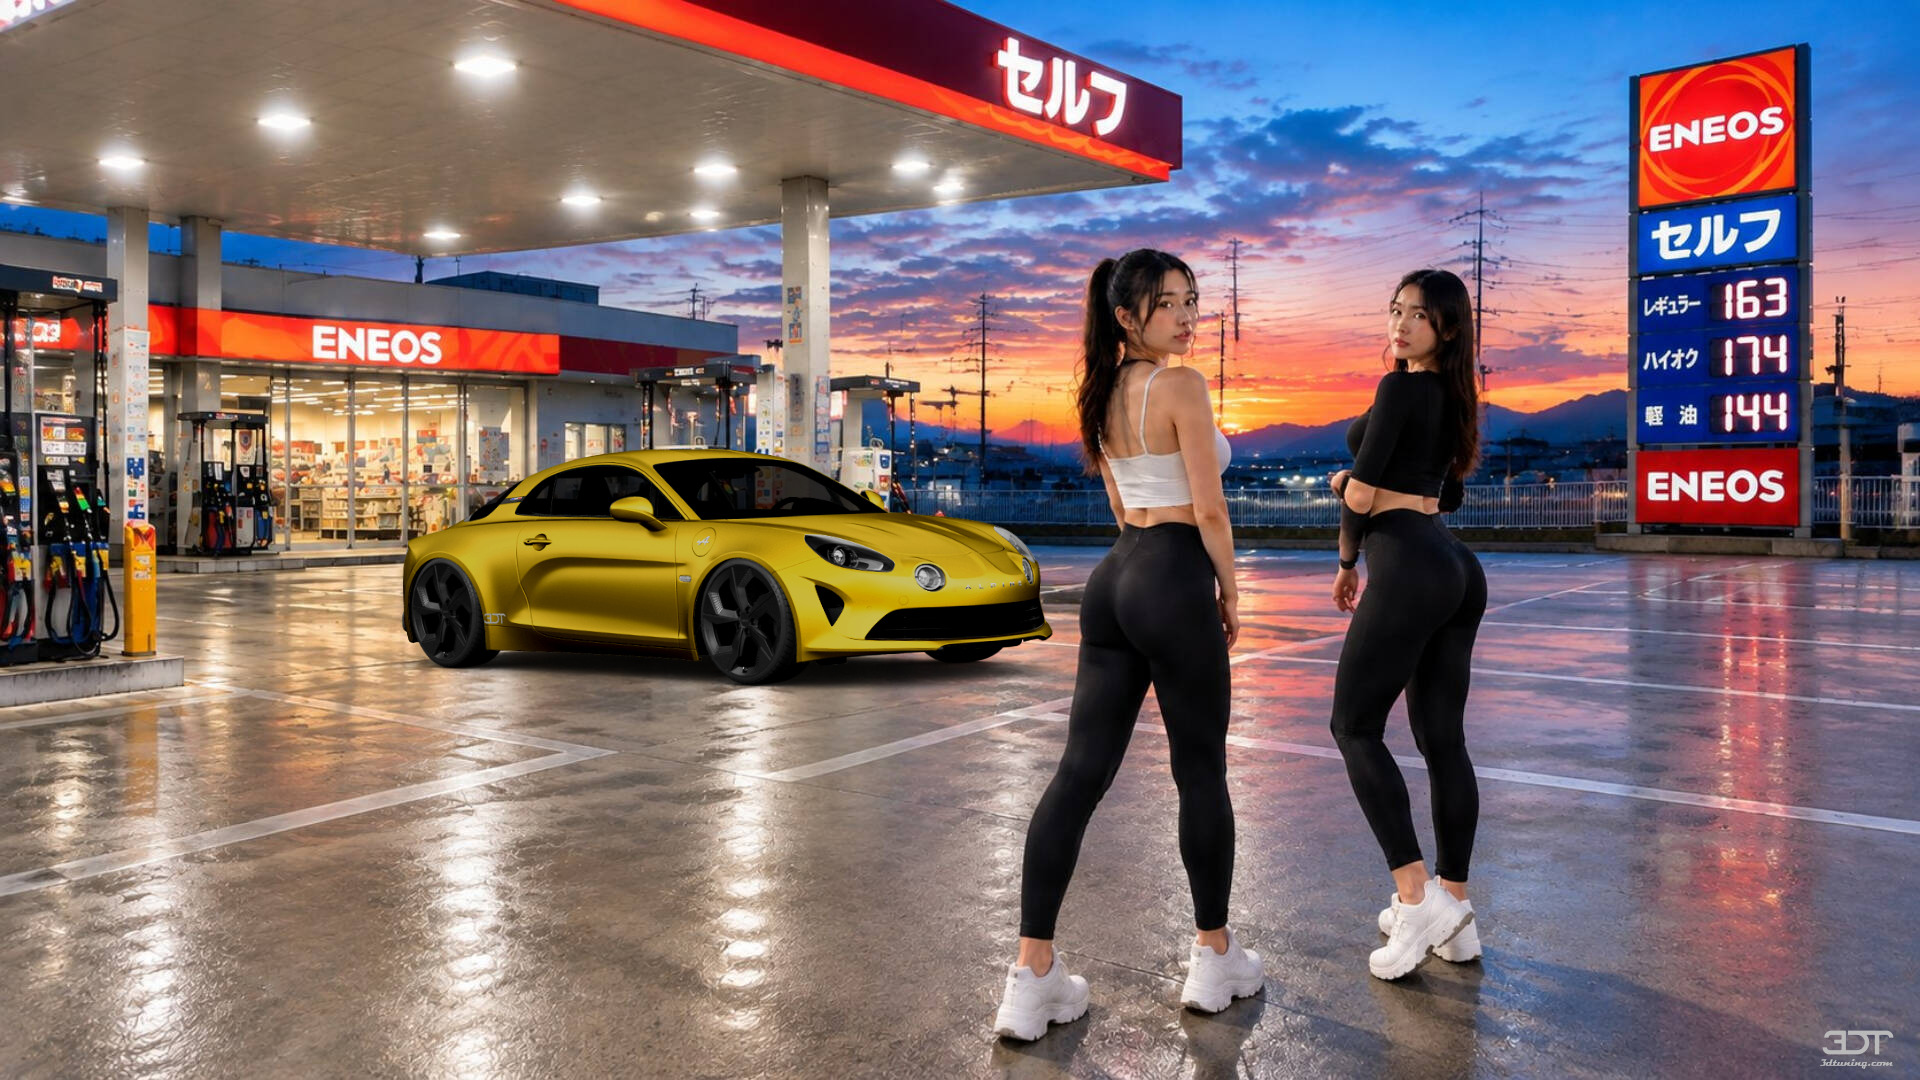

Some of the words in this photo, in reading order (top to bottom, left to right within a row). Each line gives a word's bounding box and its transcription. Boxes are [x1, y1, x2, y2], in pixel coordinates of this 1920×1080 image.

[998, 38, 1126, 135] セルフ
[1650, 107, 1783, 151] ENEOS
[1651, 209, 1780, 259] セルフ
[1644, 295, 1701, 316] レギュラー
[1723, 278, 1787, 320] 163
[312, 326, 441, 365] ENEOS
[1643, 348, 1697, 370] ハイオク
[1723, 335, 1787, 376] 174
[1723, 392, 1787, 432] 144
[1647, 470, 1785, 503] ENEOS
[484, 613, 506, 624] 3DT
